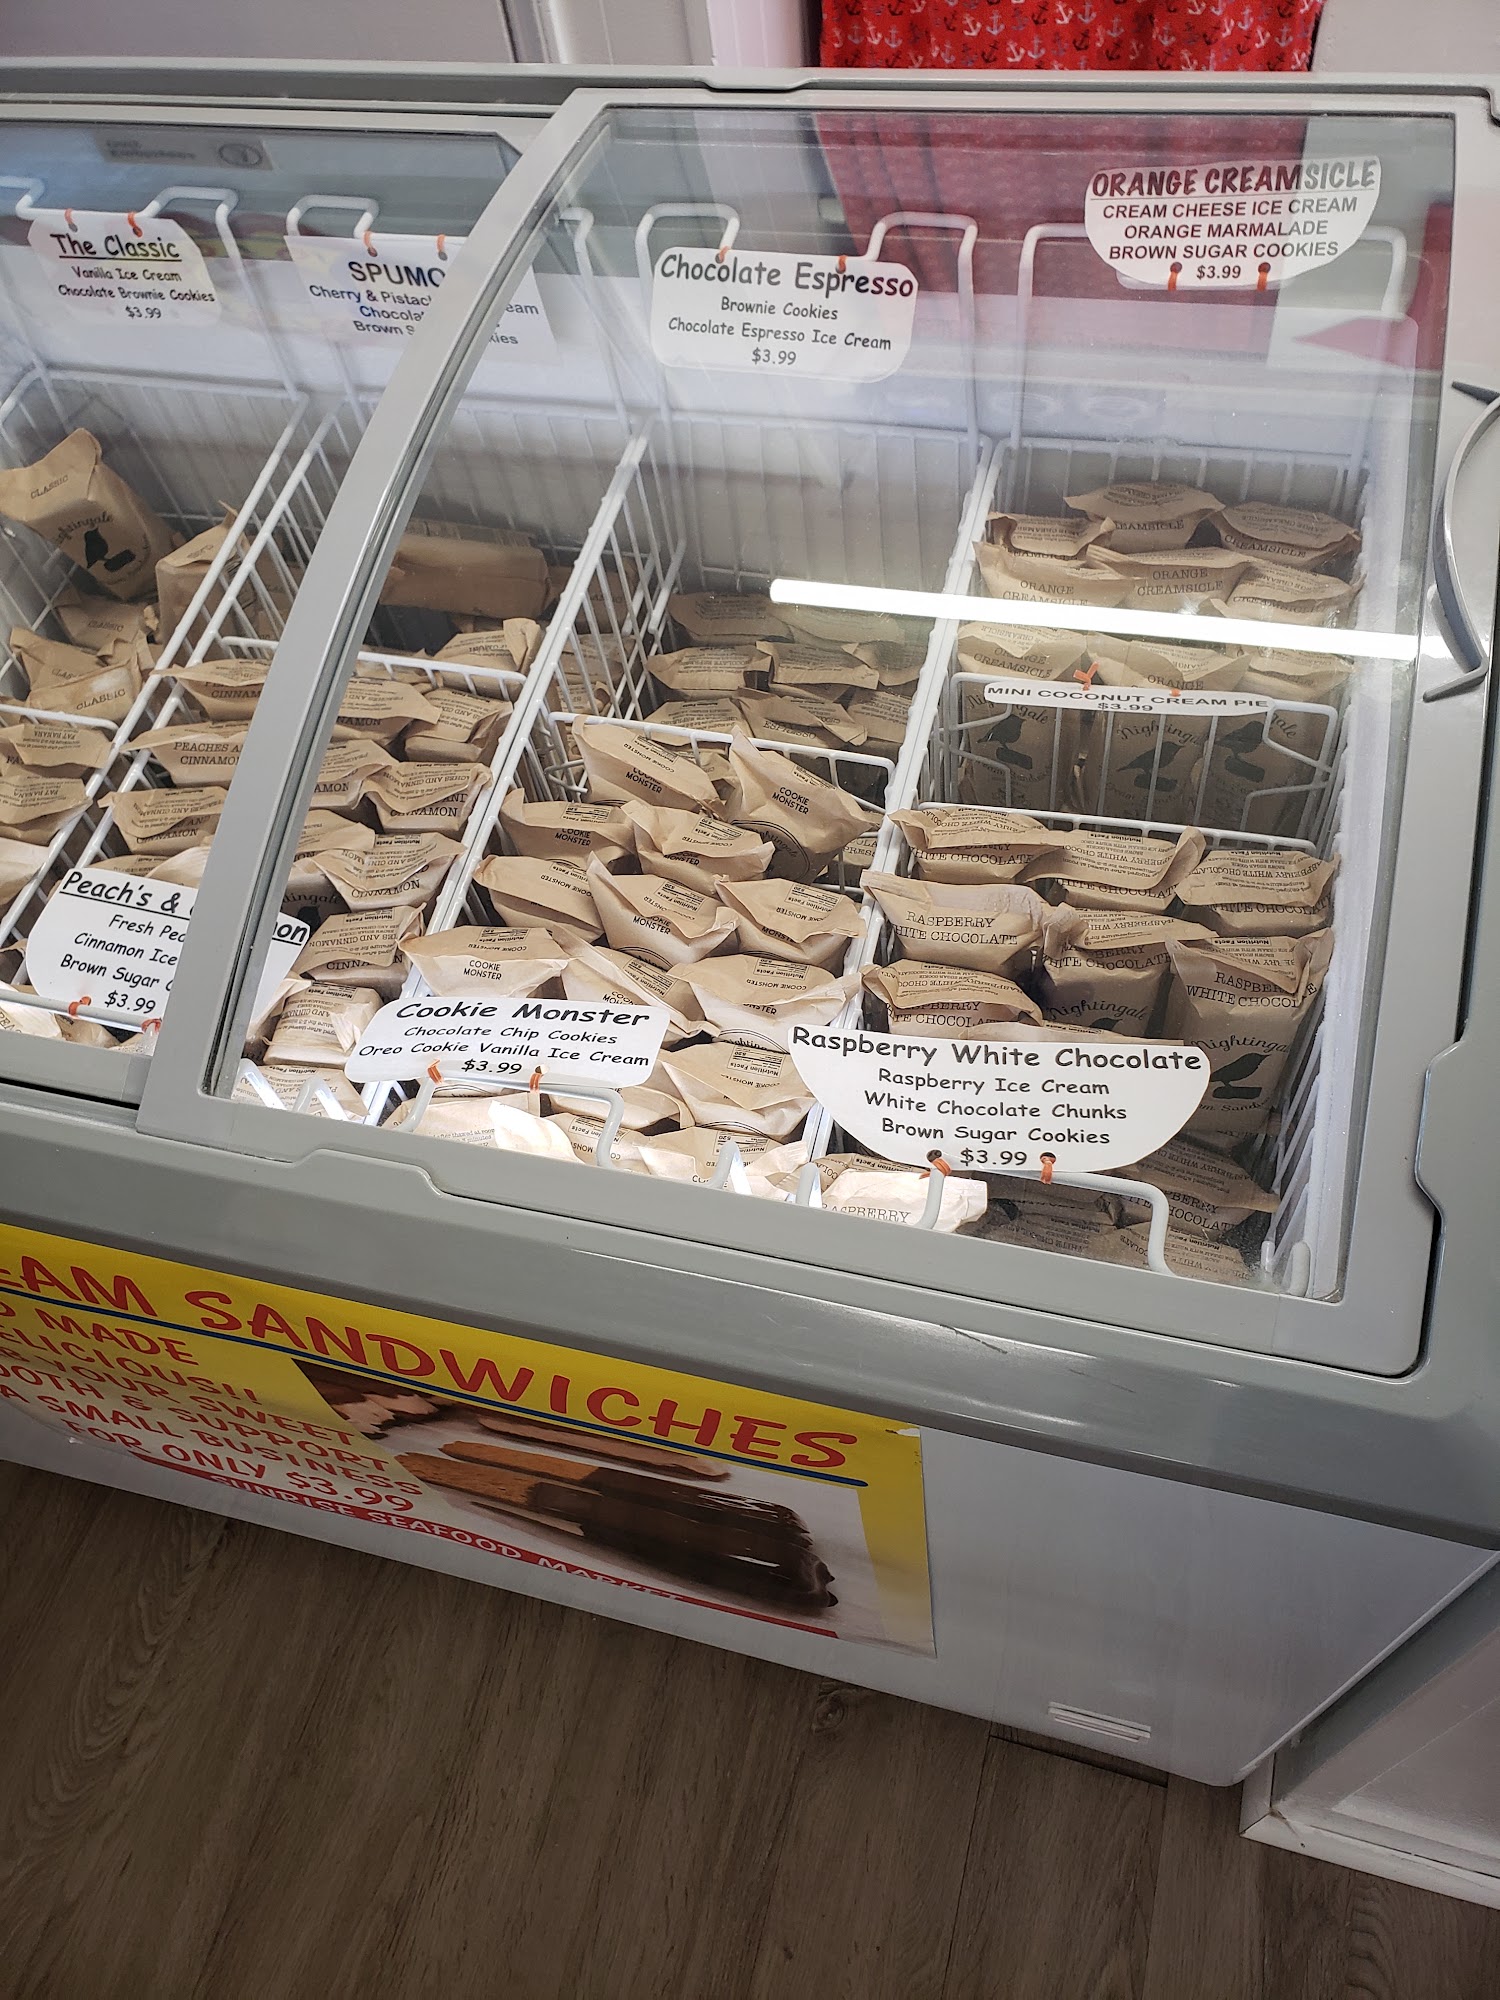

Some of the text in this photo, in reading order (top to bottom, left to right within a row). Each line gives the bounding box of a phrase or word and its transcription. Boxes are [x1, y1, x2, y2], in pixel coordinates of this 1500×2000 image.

[1092, 159, 1378, 197] ORANGE CREAMSICLE
[1103, 197, 1358, 219] CREAM CHEESE ICE CREAM
[1124, 220, 1329, 239] ORANGE MARMALADE
[50, 233, 180, 259] The Classic
[1108, 241, 1339, 260] BROWN SUGAR COOKIES
[72, 266, 182, 282] Vanilla Ice Cream
[347, 261, 447, 288] SPUMO
[660, 254, 915, 299] Chocolate Espresso
[1196, 264, 1242, 280] $3.99
[58, 284, 216, 303] Chocolate Brownie Cookies
[309, 284, 362, 304] Cherry
[366, 289, 378, 303] &
[125, 305, 162, 320] $3.99
[360, 305, 424, 322] Chocola
[721, 296, 839, 321] Brownie Cookies
[353, 320, 404, 336] Brown
[668, 317, 892, 351] Chocolate Espresso Ice Cream
[752, 347, 797, 366] $3.99
[30, 474, 69, 500] CLASSIC
[1153, 568, 1208, 581] ORANGE
[1020, 580, 1075, 595] ORANGE
[1137, 580, 1224, 597] CREAMSICLE
[973, 652, 1053, 679] CREAMSICLE
[76, 688, 126, 711] CLASSIC
[987, 686, 1270, 709] MINI COCONUT CREAM PIE
[1097, 701, 1154, 713] $3.99
[174, 741, 230, 752] PEACHES
[626, 771, 663, 794] MONSTER
[772, 793, 809, 816] MONSTER
[779, 786, 810, 806] COOKIE
[555, 833, 592, 848] MONSTER
[1097, 851, 1128, 862] WHITE
[540, 874, 571, 890] MONSTER
[1242, 869, 1273, 879] WHITE
[62, 870, 153, 907] Peach's
[160, 892, 182, 914] &
[351, 879, 421, 898] CINNAMON
[776, 906, 808, 922] MONSTER
[906, 909, 996, 928] RASPBERRY
[108, 914, 154, 936] Fresh
[633, 915, 671, 935] MONSTER
[309, 934, 380, 948] AND CINNAMON
[930, 931, 1018, 946] CHOCOLATE
[74, 932, 178, 967] Cinnamon Ice
[60, 953, 107, 978] Brown
[112, 966, 160, 992] Sugar
[463, 967, 502, 981] MONSTER
[469, 960, 502, 972] COOKIE
[746, 978, 807, 991] COOKIE MONSTER
[1186, 984, 1236, 1006] WHITE
[104, 989, 156, 1015] $3.99
[396, 1001, 651, 1027] Cookie Monster
[404, 1026, 618, 1045] Chocolate Chip Cookies
[359, 1041, 650, 1067] Oreo Cookie Vanilla Ice Cream
[792, 1026, 938, 1067] Raspberry
[952, 1043, 1041, 1068] White
[1055, 1048, 1203, 1071] Chocolate
[461, 1059, 523, 1076] $3.99
[878, 1067, 1110, 1096] Raspberry Ice Cream
[864, 1090, 1128, 1120] White Chocolate Chunks
[882, 1117, 1112, 1145] Brown Sugar Cookies
[960, 1146, 1028, 1167] $3.99
[35, 1307, 199, 1366] MADE
[185, 1290, 859, 1470] SANDWICHES
[34, 1355, 356, 1446] YOUR SWEET
[37, 1395, 185, 1440] SMALL
[189, 1429, 423, 1496] BUSINESS
[168, 1407, 390, 1472] SUPPORT
[61, 1418, 414, 1512] FOR ONLY $3.99
[209, 1474, 355, 1518] SUNRISE
[367, 1510, 523, 1559] SEAFOOD
